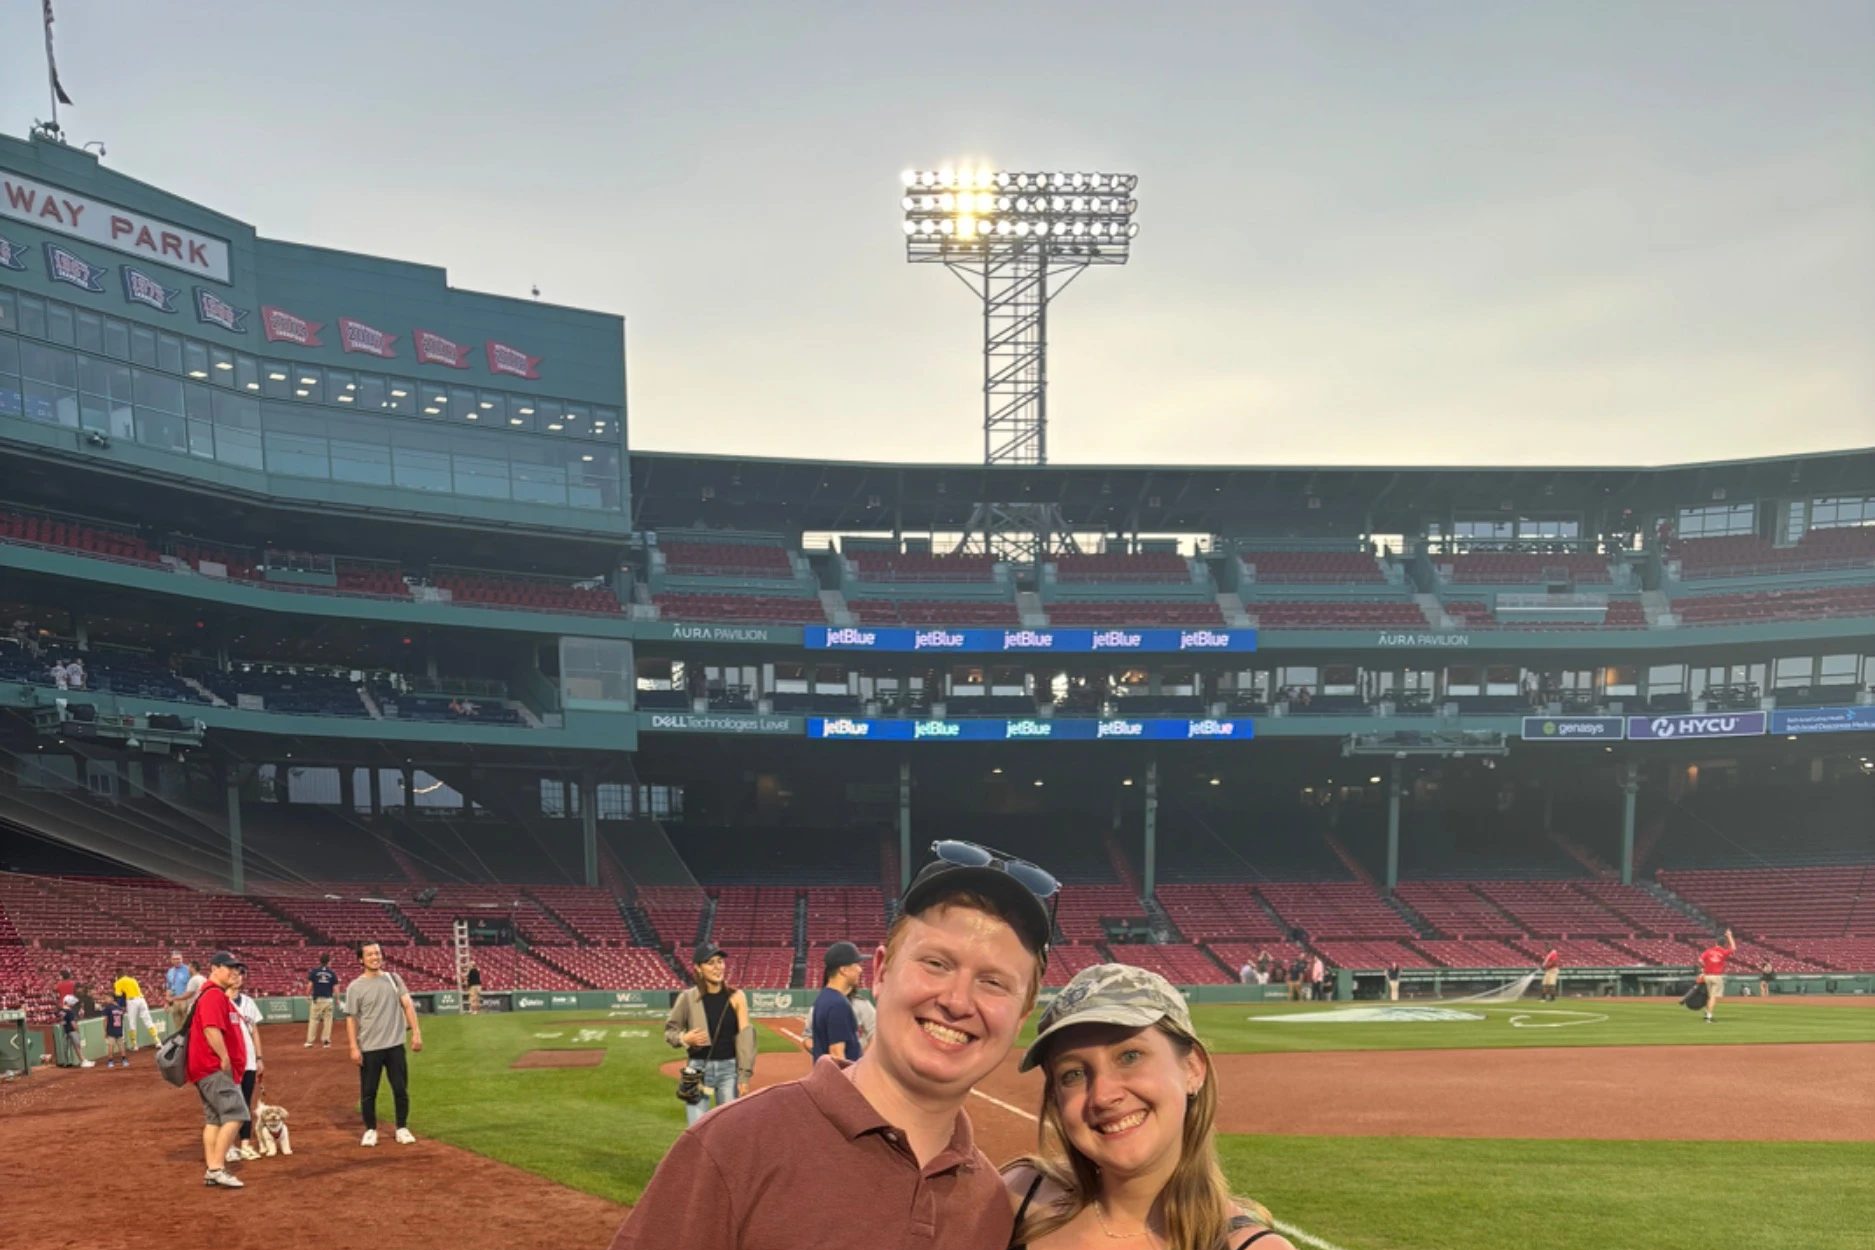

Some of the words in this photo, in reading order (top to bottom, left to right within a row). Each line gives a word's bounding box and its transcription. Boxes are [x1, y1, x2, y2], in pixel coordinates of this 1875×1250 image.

[5, 181, 84, 227] WAY
[111, 215, 209, 268] PARK
[714, 628, 767, 641] PAVILION
[826, 628, 876, 647] jetBlue
[915, 631, 965, 649] jetBlue
[1003, 631, 1053, 650] jetBlue
[1092, 631, 1142, 650] jetBlue
[1180, 631, 1230, 650] jetBlue
[1417, 635, 1469, 646] PAVILION
[687, 717, 758, 732] Technologies
[760, 719, 789, 731] Level
[823, 719, 870, 738] jetBlue
[914, 721, 960, 739] jetBlue
[1006, 721, 1051, 739] jetBlue
[1097, 721, 1144, 739] jetBlue
[1188, 720, 1234, 739] jetBlue
[1558, 722, 1604, 736] genasys
[1678, 717, 1736, 734] HYCU
